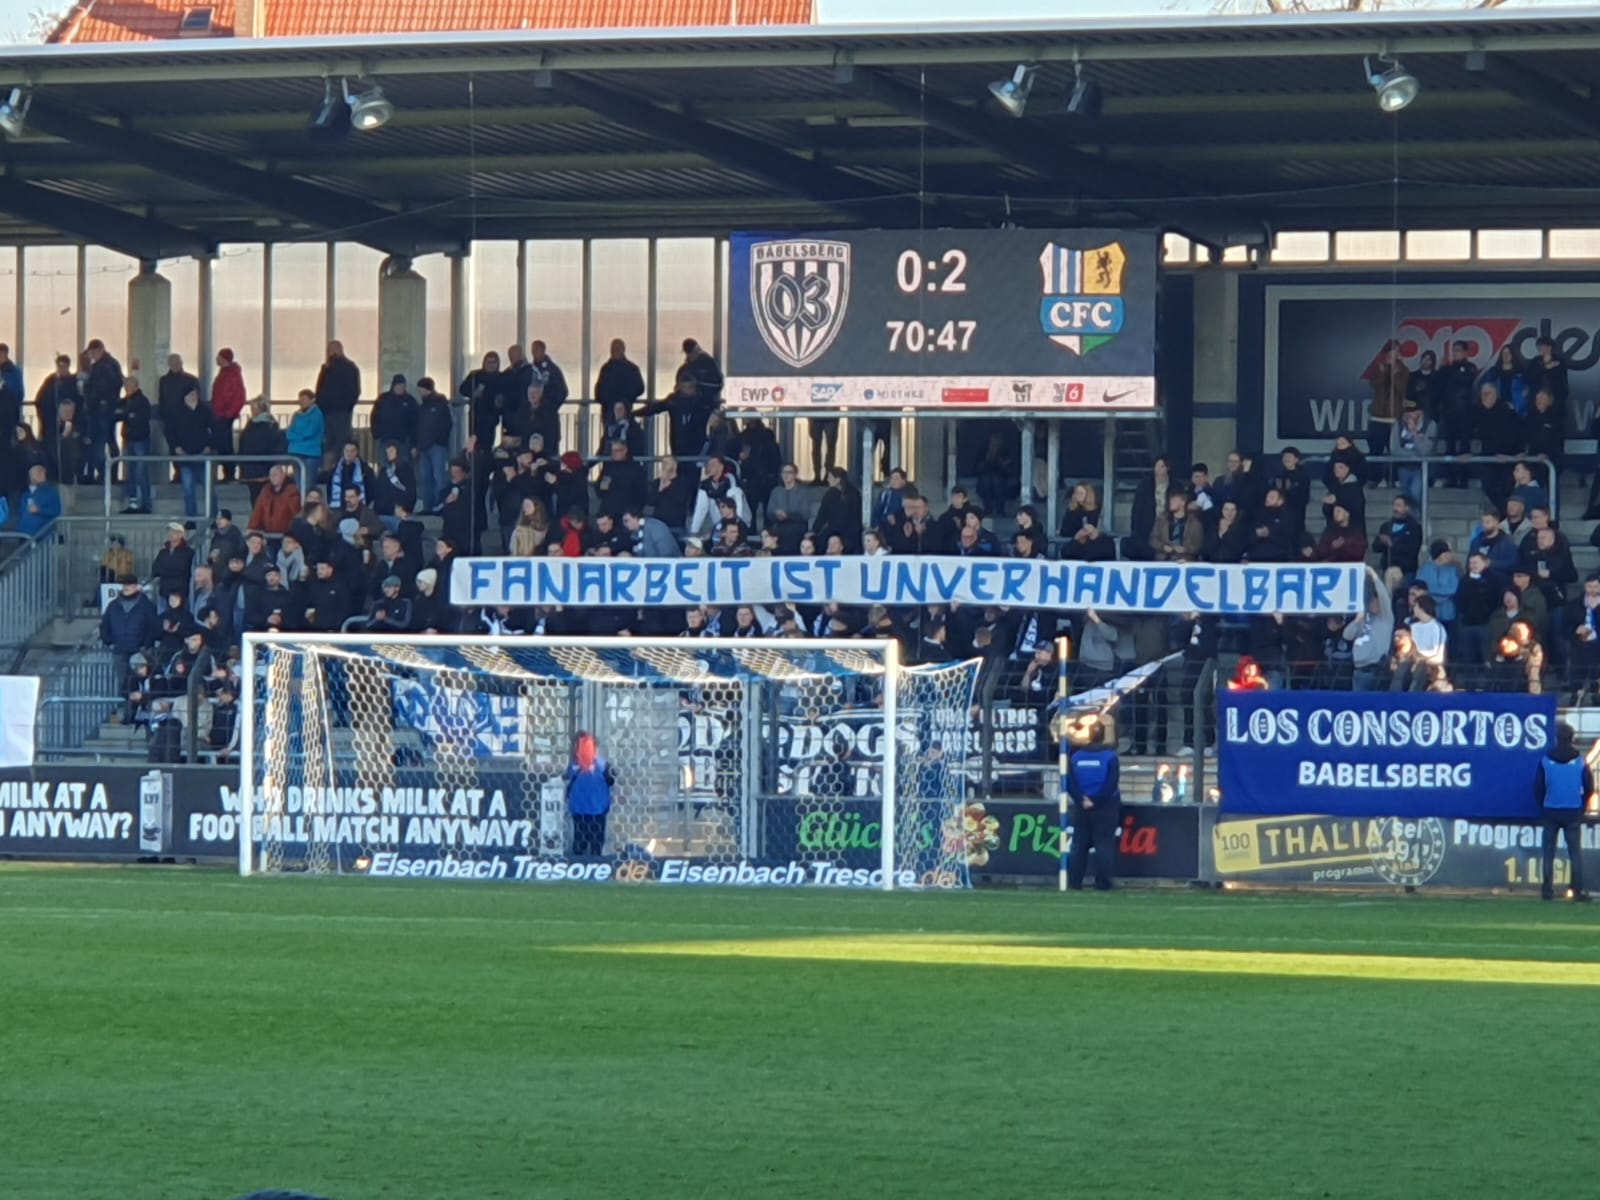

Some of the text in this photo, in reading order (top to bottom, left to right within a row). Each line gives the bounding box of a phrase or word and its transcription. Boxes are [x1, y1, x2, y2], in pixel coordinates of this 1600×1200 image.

[757, 243, 844, 259] BABELSBERG
[896, 249, 967, 293] 0:2
[1049, 302, 1112, 328] CFC
[886, 320, 977, 352] 70:47
[741, 387, 768, 401] EWP
[469, 560, 750, 603] FANARBEIT
[770, 559, 842, 601] IST
[1226, 707, 1547, 750] LOS CONSORTOS
[1298, 760, 1472, 788] BABELSBERG
[54, 782, 86, 809] AT
[90, 782, 108, 810] A
[287, 786, 377, 814] DRINKS
[382, 787, 446, 815] MILK
[450, 788, 484, 816] AT
[488, 789, 507, 817] A
[10, 810, 133, 839] ANYWAY?
[314, 816, 399, 844] MATCH
[405, 817, 533, 847] ANYWAY?
[1221, 820, 1383, 857] 100 THALIA
[369, 852, 507, 880] Eisenbach
[512, 855, 612, 881] Tresore
[661, 859, 806, 885] Eisenbach
[811, 861, 916, 888] Tresoe
[1312, 865, 1374, 882] programm
[1504, 856, 1521, 883] 1.
